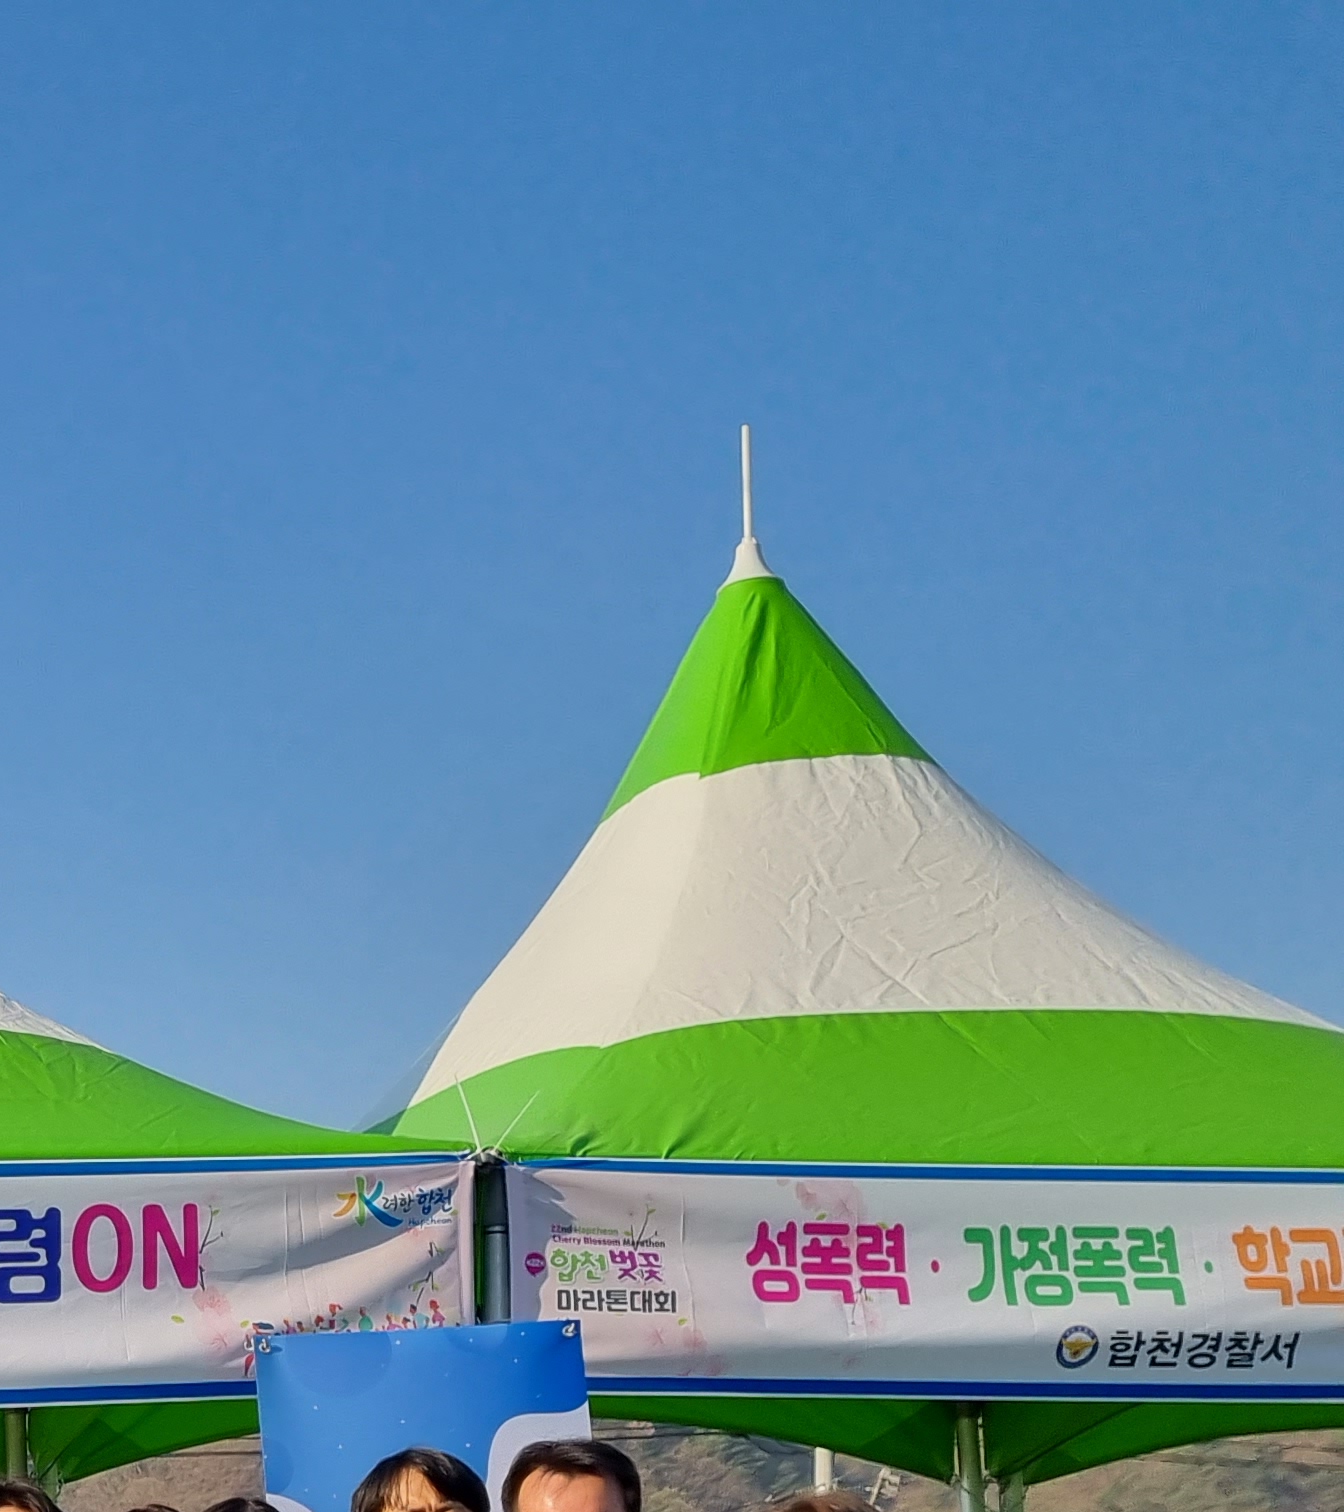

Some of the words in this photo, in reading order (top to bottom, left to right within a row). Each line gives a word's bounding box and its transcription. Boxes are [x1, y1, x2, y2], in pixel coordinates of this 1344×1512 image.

[415, 1187, 453, 1216] 합천
[552, 1234, 581, 1246] Cherry
[583, 1236, 621, 1247] Blossom
[550, 1249, 608, 1283] 합천
[609, 1250, 663, 1282] 벚꽃
[746, 1220, 911, 1306] 성폭력
[963, 1224, 1186, 1307] 가정폭력
[1231, 1224, 1344, 1307] 학교
[557, 1289, 677, 1313] 마라톤대회
[1108, 1330, 1302, 1370] 합천경찰서
